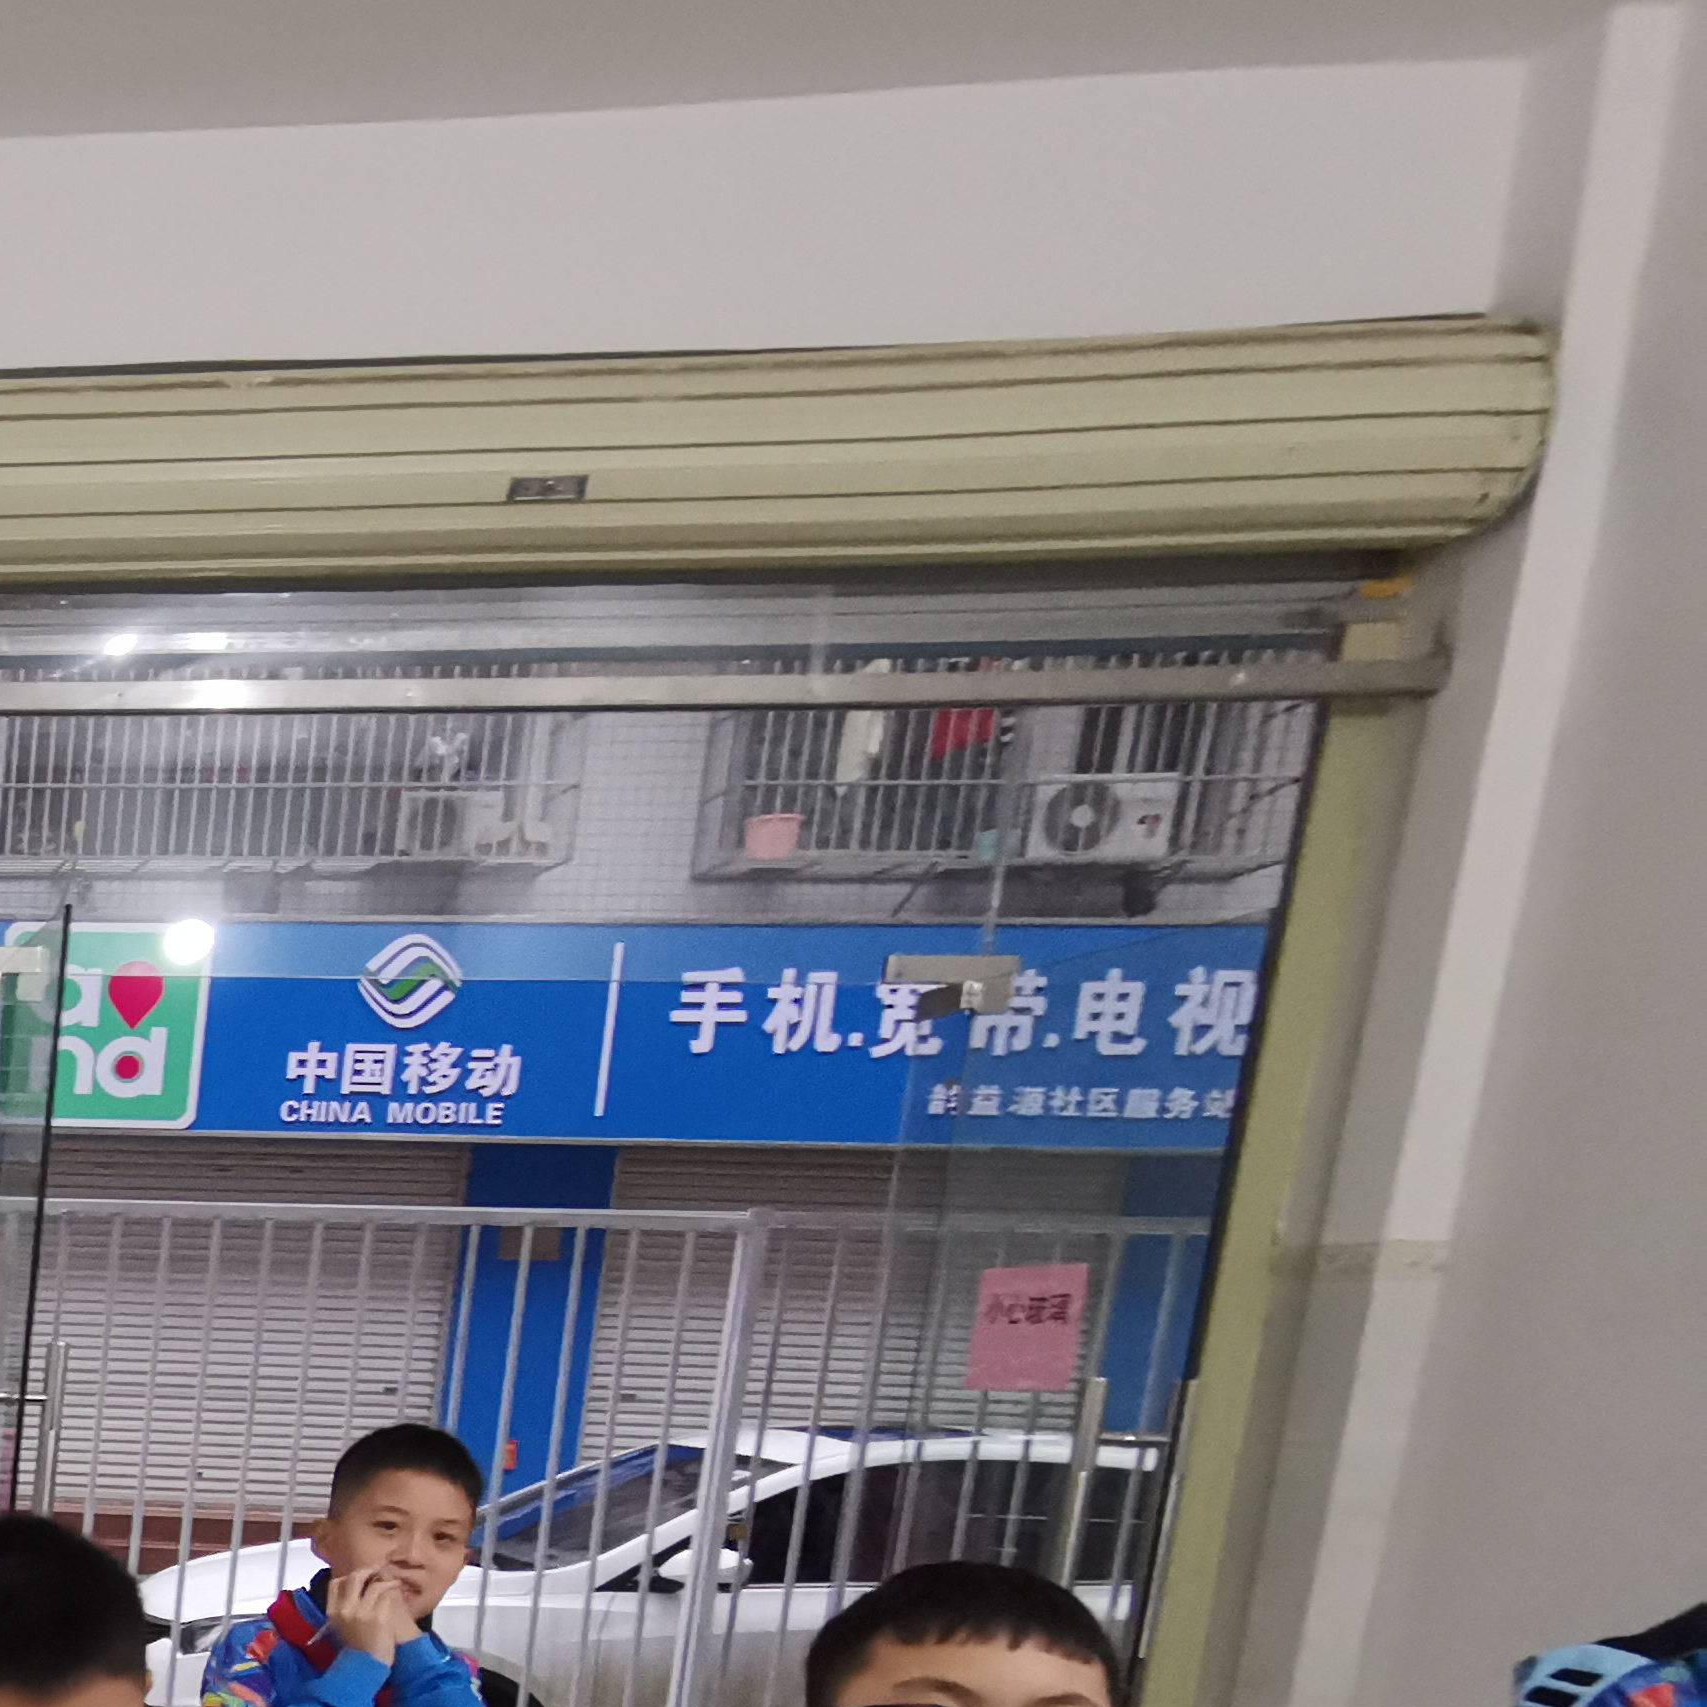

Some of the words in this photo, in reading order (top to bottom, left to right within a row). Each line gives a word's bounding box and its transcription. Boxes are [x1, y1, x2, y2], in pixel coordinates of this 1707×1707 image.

[285, 1040, 523, 1098] 中国移动
[279, 1099, 373, 1124] CHINA
[386, 1101, 506, 1126] MOBILE
